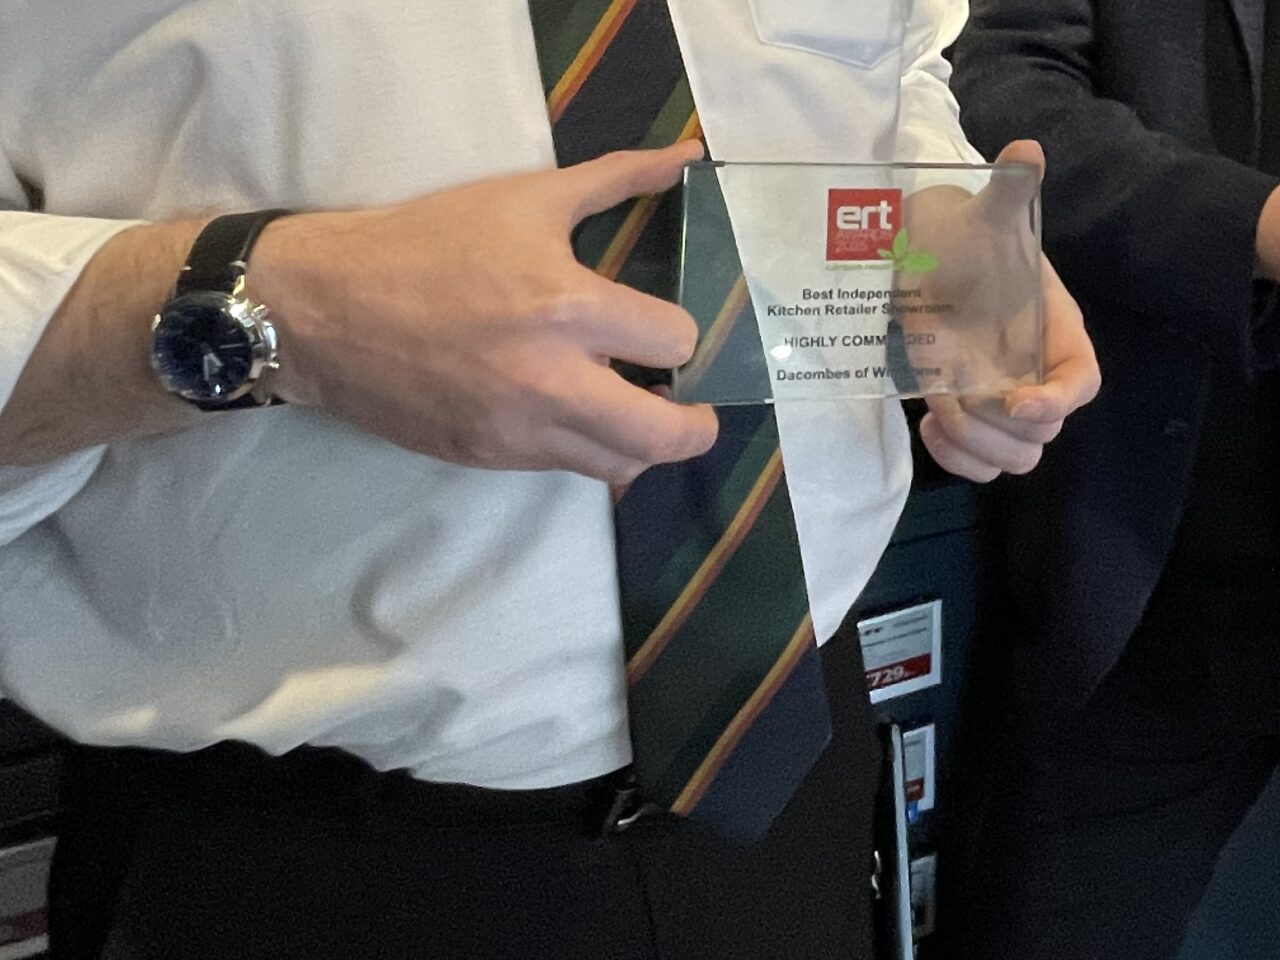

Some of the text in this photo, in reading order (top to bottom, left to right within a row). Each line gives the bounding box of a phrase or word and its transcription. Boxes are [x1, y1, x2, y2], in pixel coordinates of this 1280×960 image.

[836, 200, 892, 230] ert
[802, 288, 834, 301] Best
[767, 303, 821, 317] Kitchen
[825, 303, 878, 316] Retailer
[784, 335, 838, 348] HIGHLY
[776, 367, 850, 382] Dacombes
[854, 366, 869, 379] of
